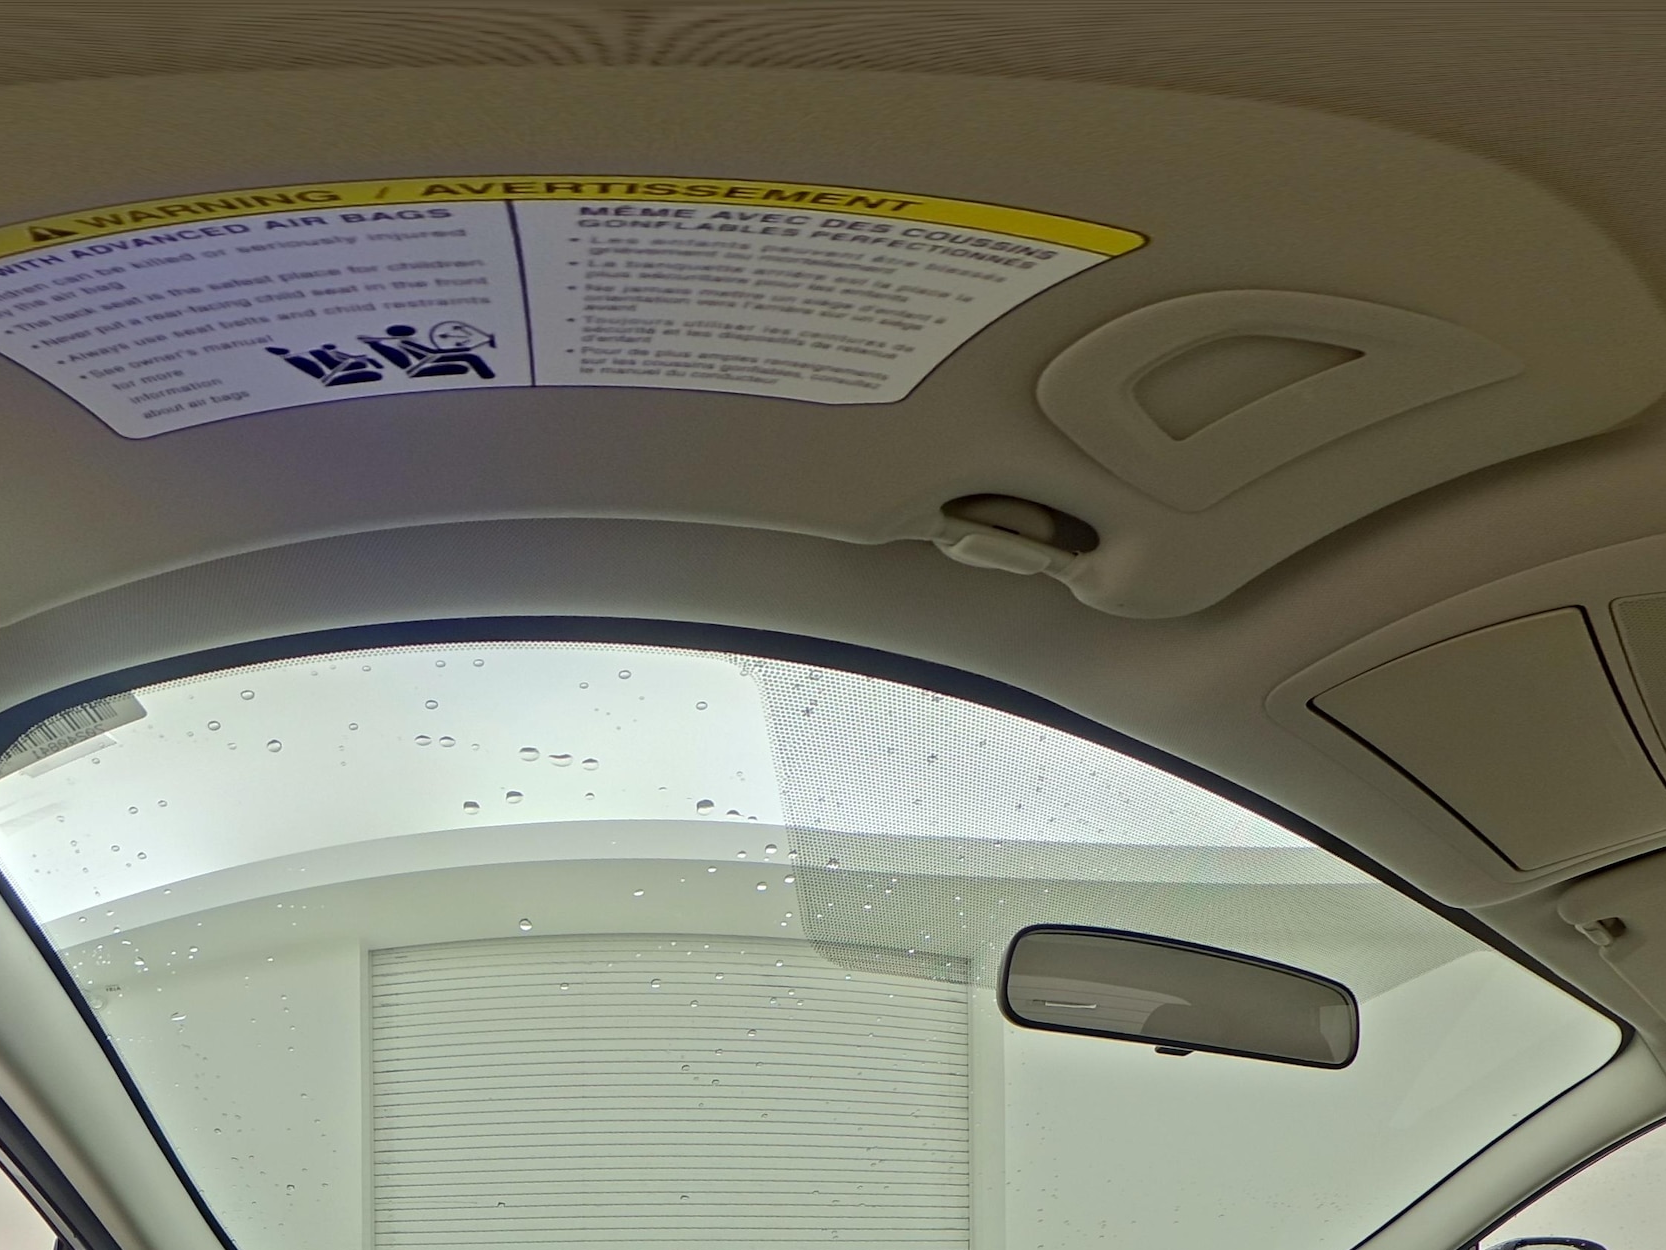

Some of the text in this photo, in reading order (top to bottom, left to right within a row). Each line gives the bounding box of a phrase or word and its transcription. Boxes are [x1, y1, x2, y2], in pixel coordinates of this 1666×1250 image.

[74, 190, 342, 229] WARNING
[420, 182, 923, 212] AVERTISSEMENT
[577, 219, 801, 237] GONFLABLES
[71, 223, 251, 259] ADVANCED
[265, 216, 328, 230] AIR
[340, 208, 453, 223] BAGS
[579, 204, 1059, 260] MÊME AVEC DES COUSSINS
[52, 271, 93, 287] can
[94, 265, 126, 277] be
